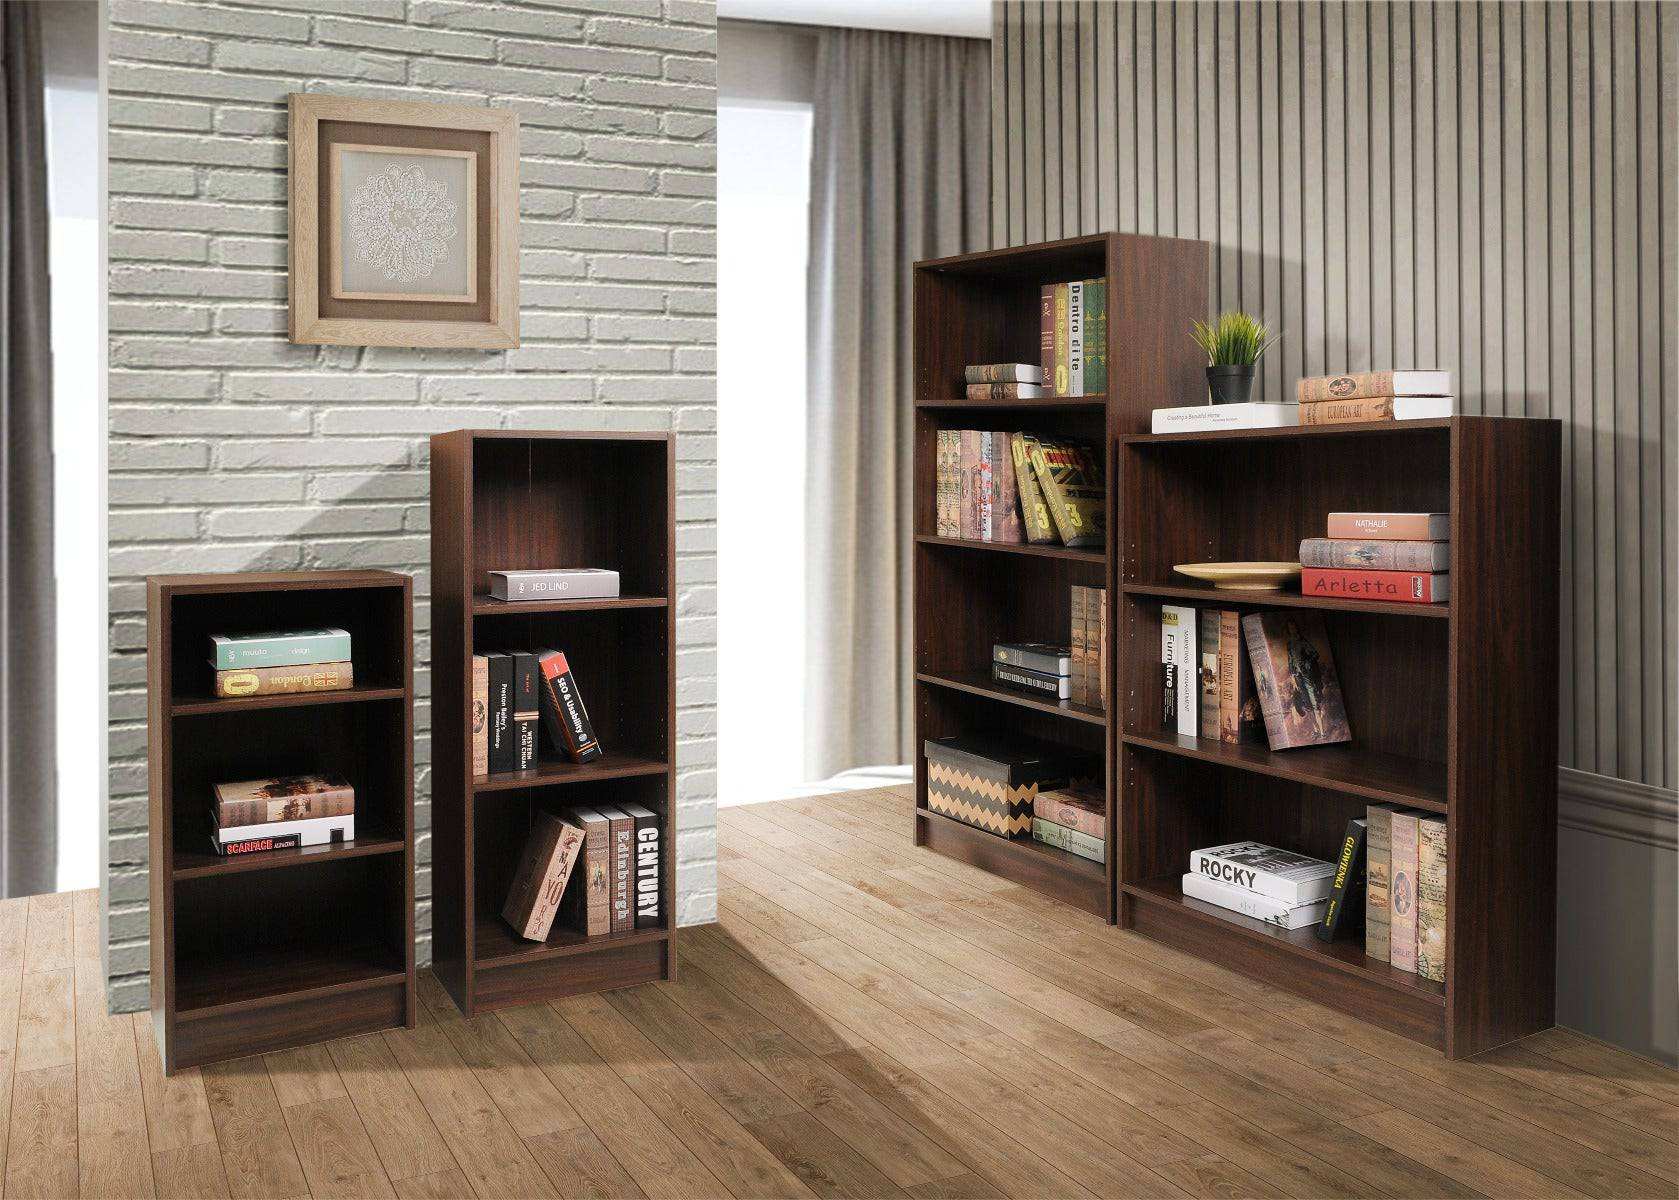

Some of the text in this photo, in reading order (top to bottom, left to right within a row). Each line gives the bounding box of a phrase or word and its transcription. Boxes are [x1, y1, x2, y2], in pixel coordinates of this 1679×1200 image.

[1071, 285, 1080, 371] Dentro di te
[1355, 519, 1389, 528] NATHALIE
[530, 582, 547, 592] JED
[548, 581, 569, 592] LIND
[1314, 577, 1398, 594] Arletta
[1166, 633, 1175, 688] Furniture
[557, 677, 584, 734] SEO & Usability
[226, 839, 273, 855] SCARFACE
[637, 827, 659, 918] CENTURY
[1200, 856, 1257, 889] ROCKY
[1333, 836, 1355, 889] GLOWIENKA
[614, 830, 630, 920] Edinburgh
